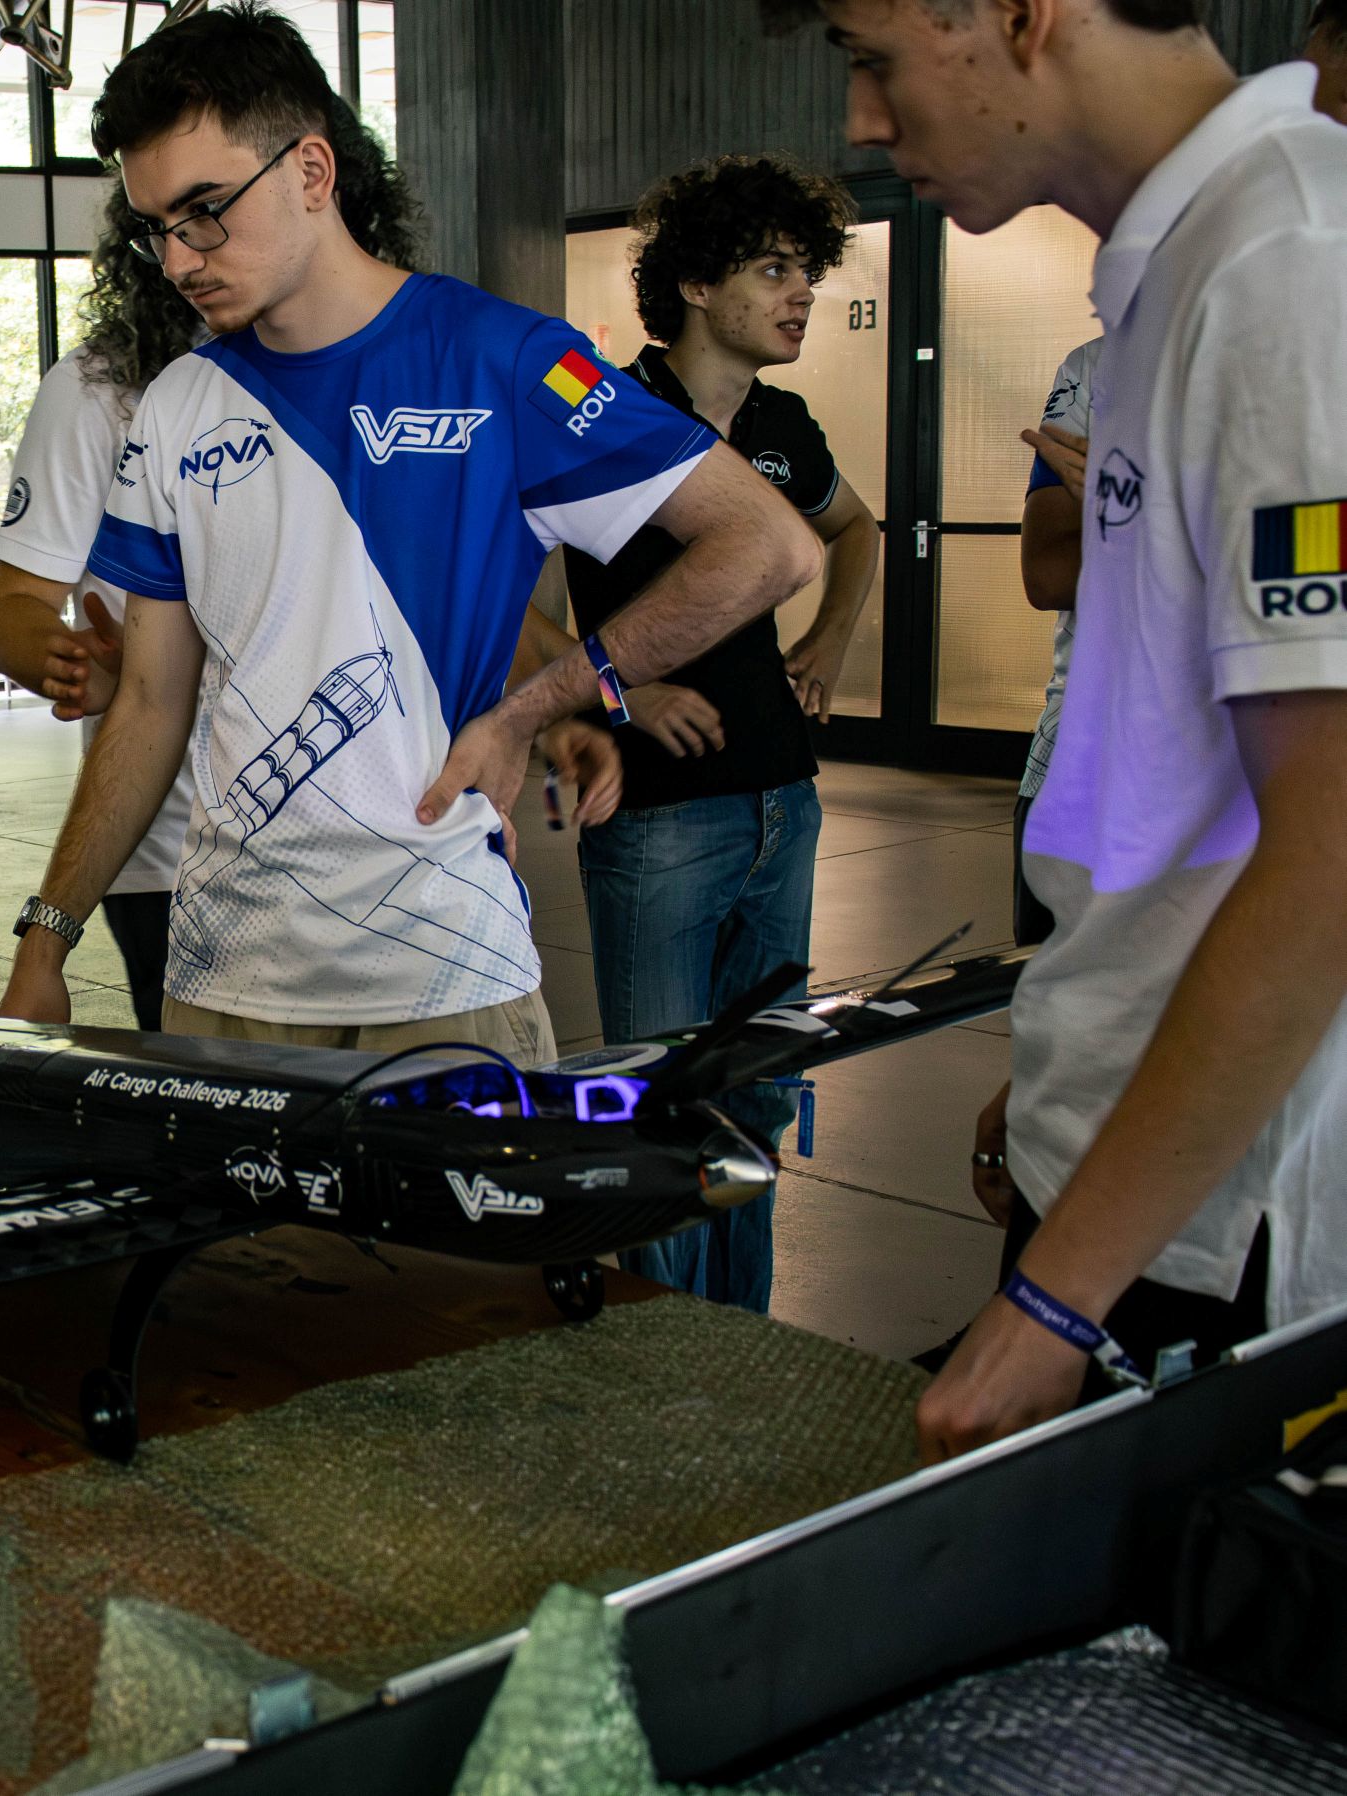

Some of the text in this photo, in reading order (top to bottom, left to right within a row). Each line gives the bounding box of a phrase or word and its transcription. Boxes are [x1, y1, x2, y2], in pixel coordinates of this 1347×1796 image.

[566, 380, 616, 437] ROU
[179, 433, 275, 480] NOVA
[351, 406, 490, 464] VSIX
[752, 458, 791, 479] NOVA
[1261, 580, 1347, 618] RO
[84, 1068, 291, 1112] Air Cargo Challenge 2026
